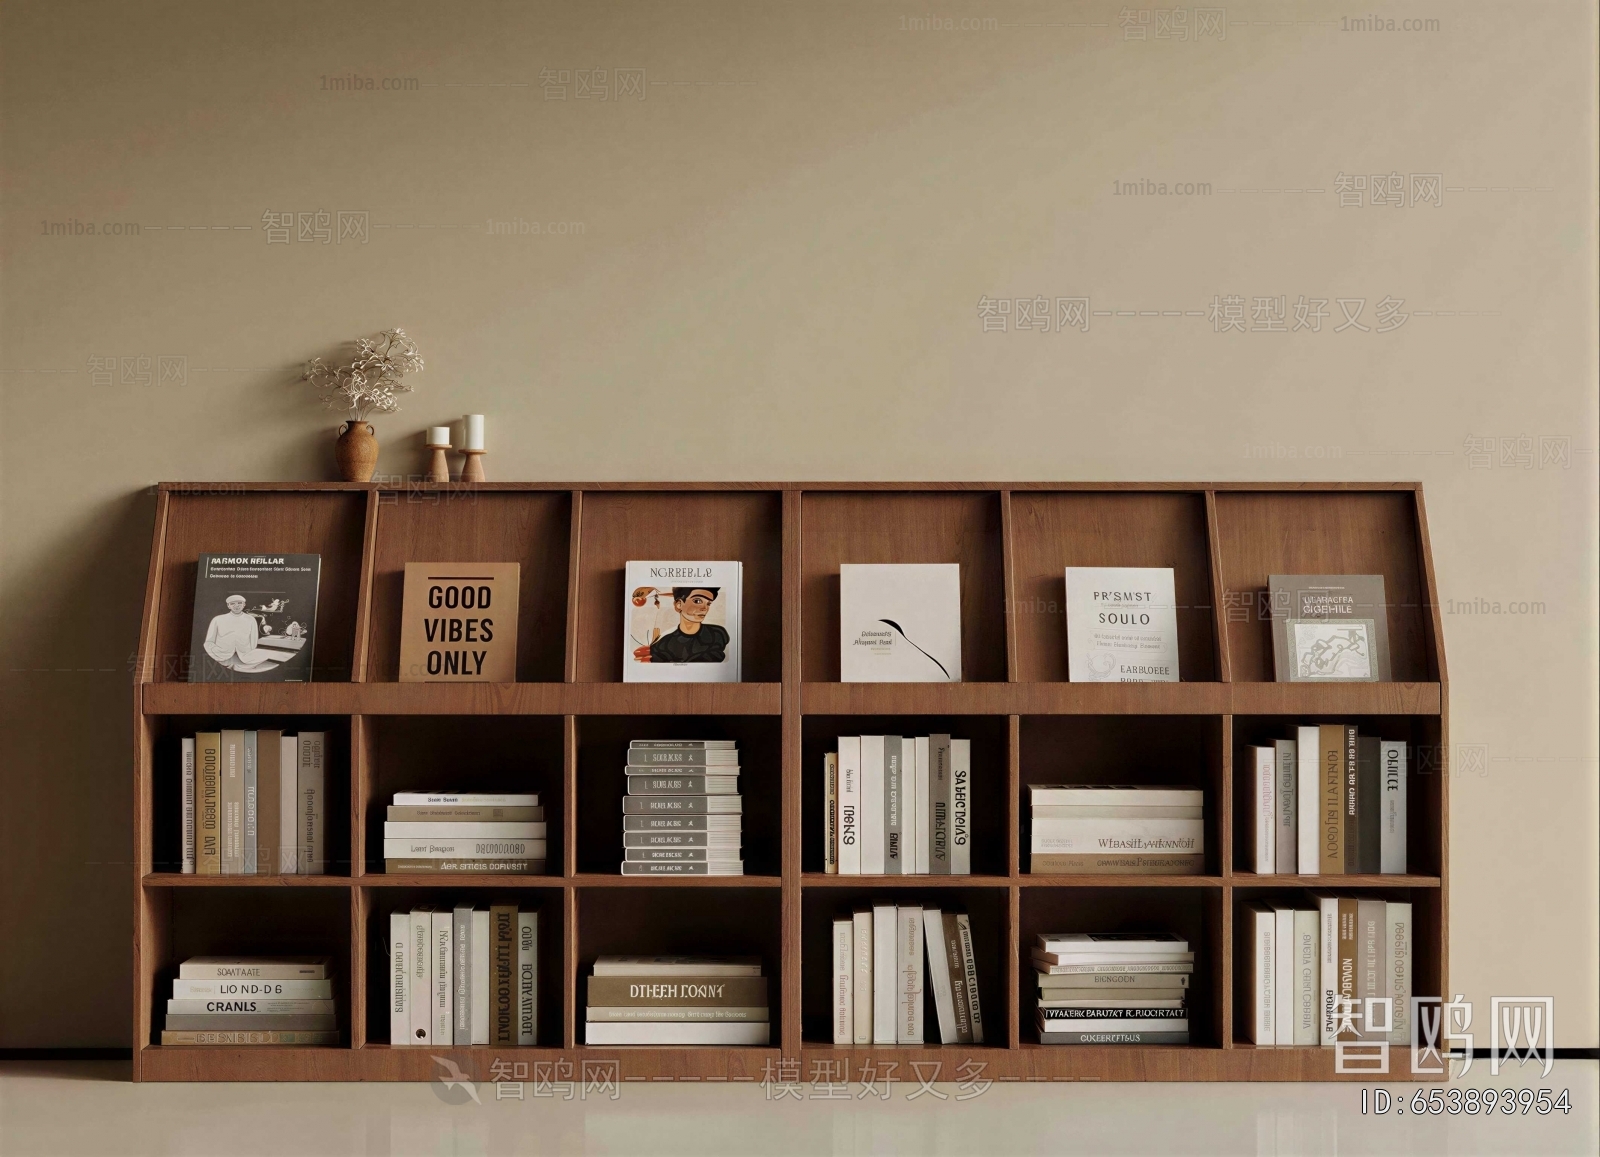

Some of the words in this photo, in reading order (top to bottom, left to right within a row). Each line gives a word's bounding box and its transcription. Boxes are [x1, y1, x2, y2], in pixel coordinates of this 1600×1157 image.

[428, 585, 491, 610] GOOD
[424, 618, 494, 643] VIBES
[1098, 612, 1150, 626] SOULO
[427, 650, 487, 676] ONLY
[206, 1001, 258, 1013] CRANLS
